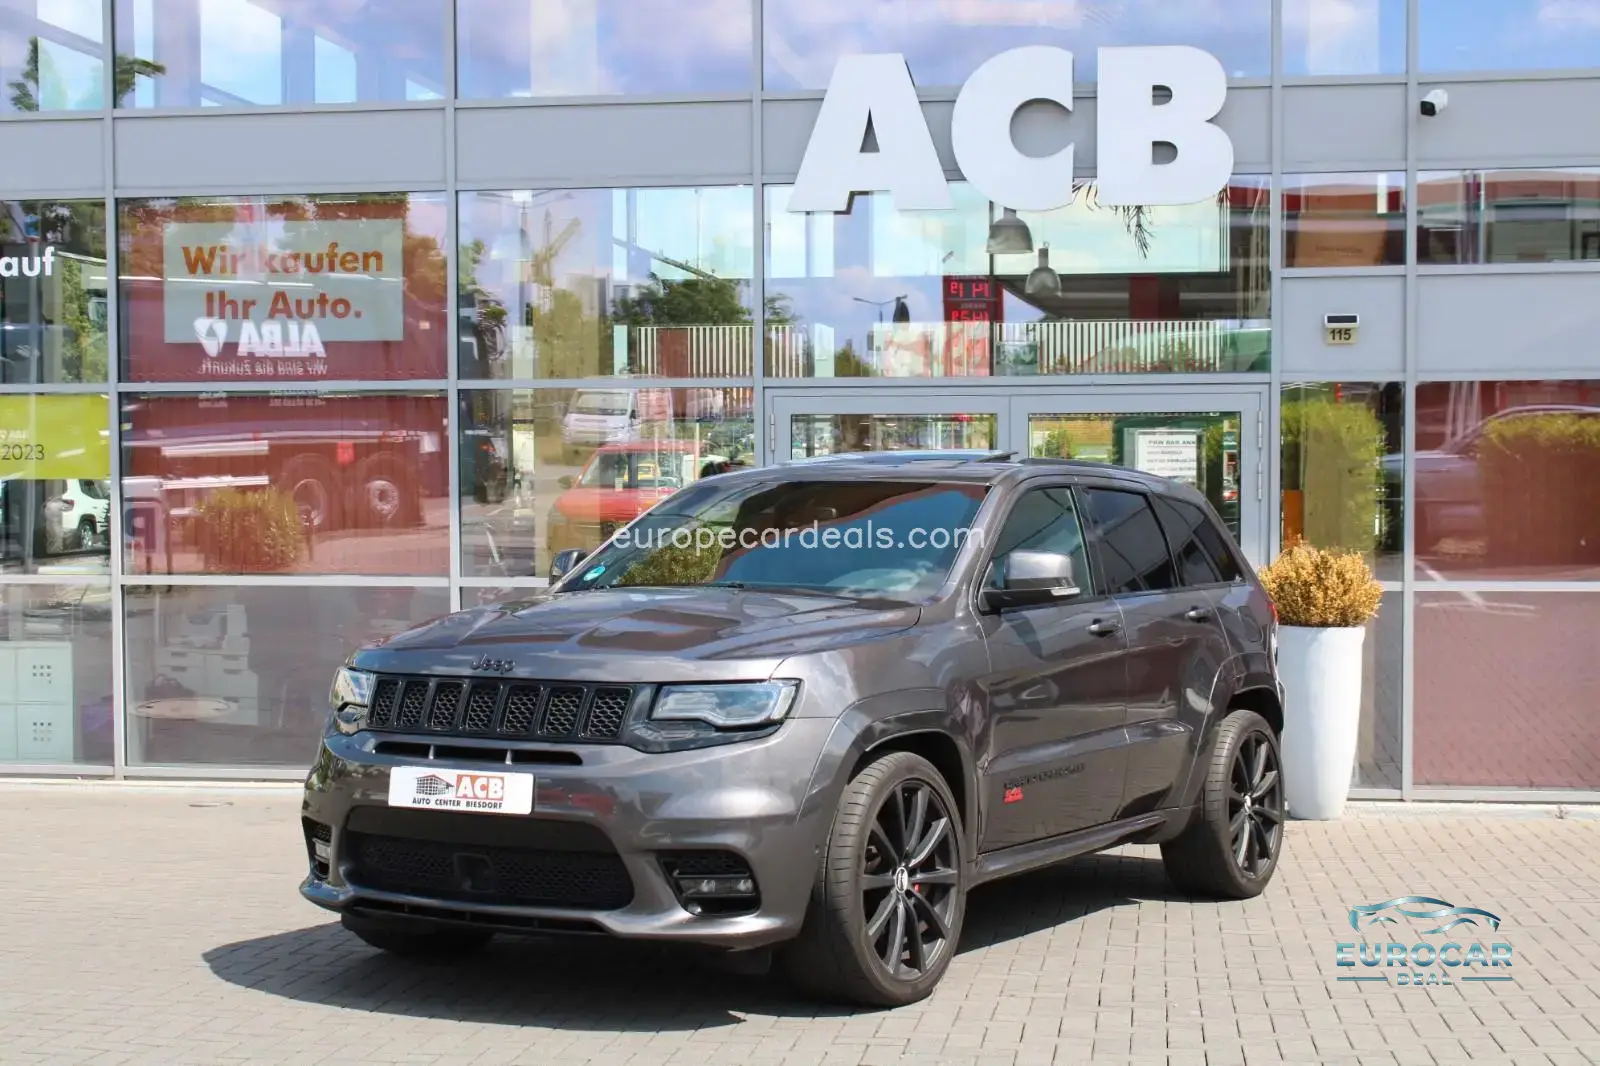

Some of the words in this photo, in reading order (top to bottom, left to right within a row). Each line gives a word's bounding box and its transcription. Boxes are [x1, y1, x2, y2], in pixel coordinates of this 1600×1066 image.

[787, 45, 1234, 213] ACB
[0, 246, 55, 277] auf
[181, 245, 246, 275] Wir
[258, 241, 383, 274] kaufen
[206, 290, 256, 319] Ihr
[268, 291, 362, 319] Auto.
[1330, 328, 1352, 341] 115
[1, 444, 45, 461] 2023
[470, 652, 515, 675] Jeep
[456, 775, 503, 800] ACB
[435, 799, 461, 807] CENTER
[466, 801, 503, 809] BIESDORF
